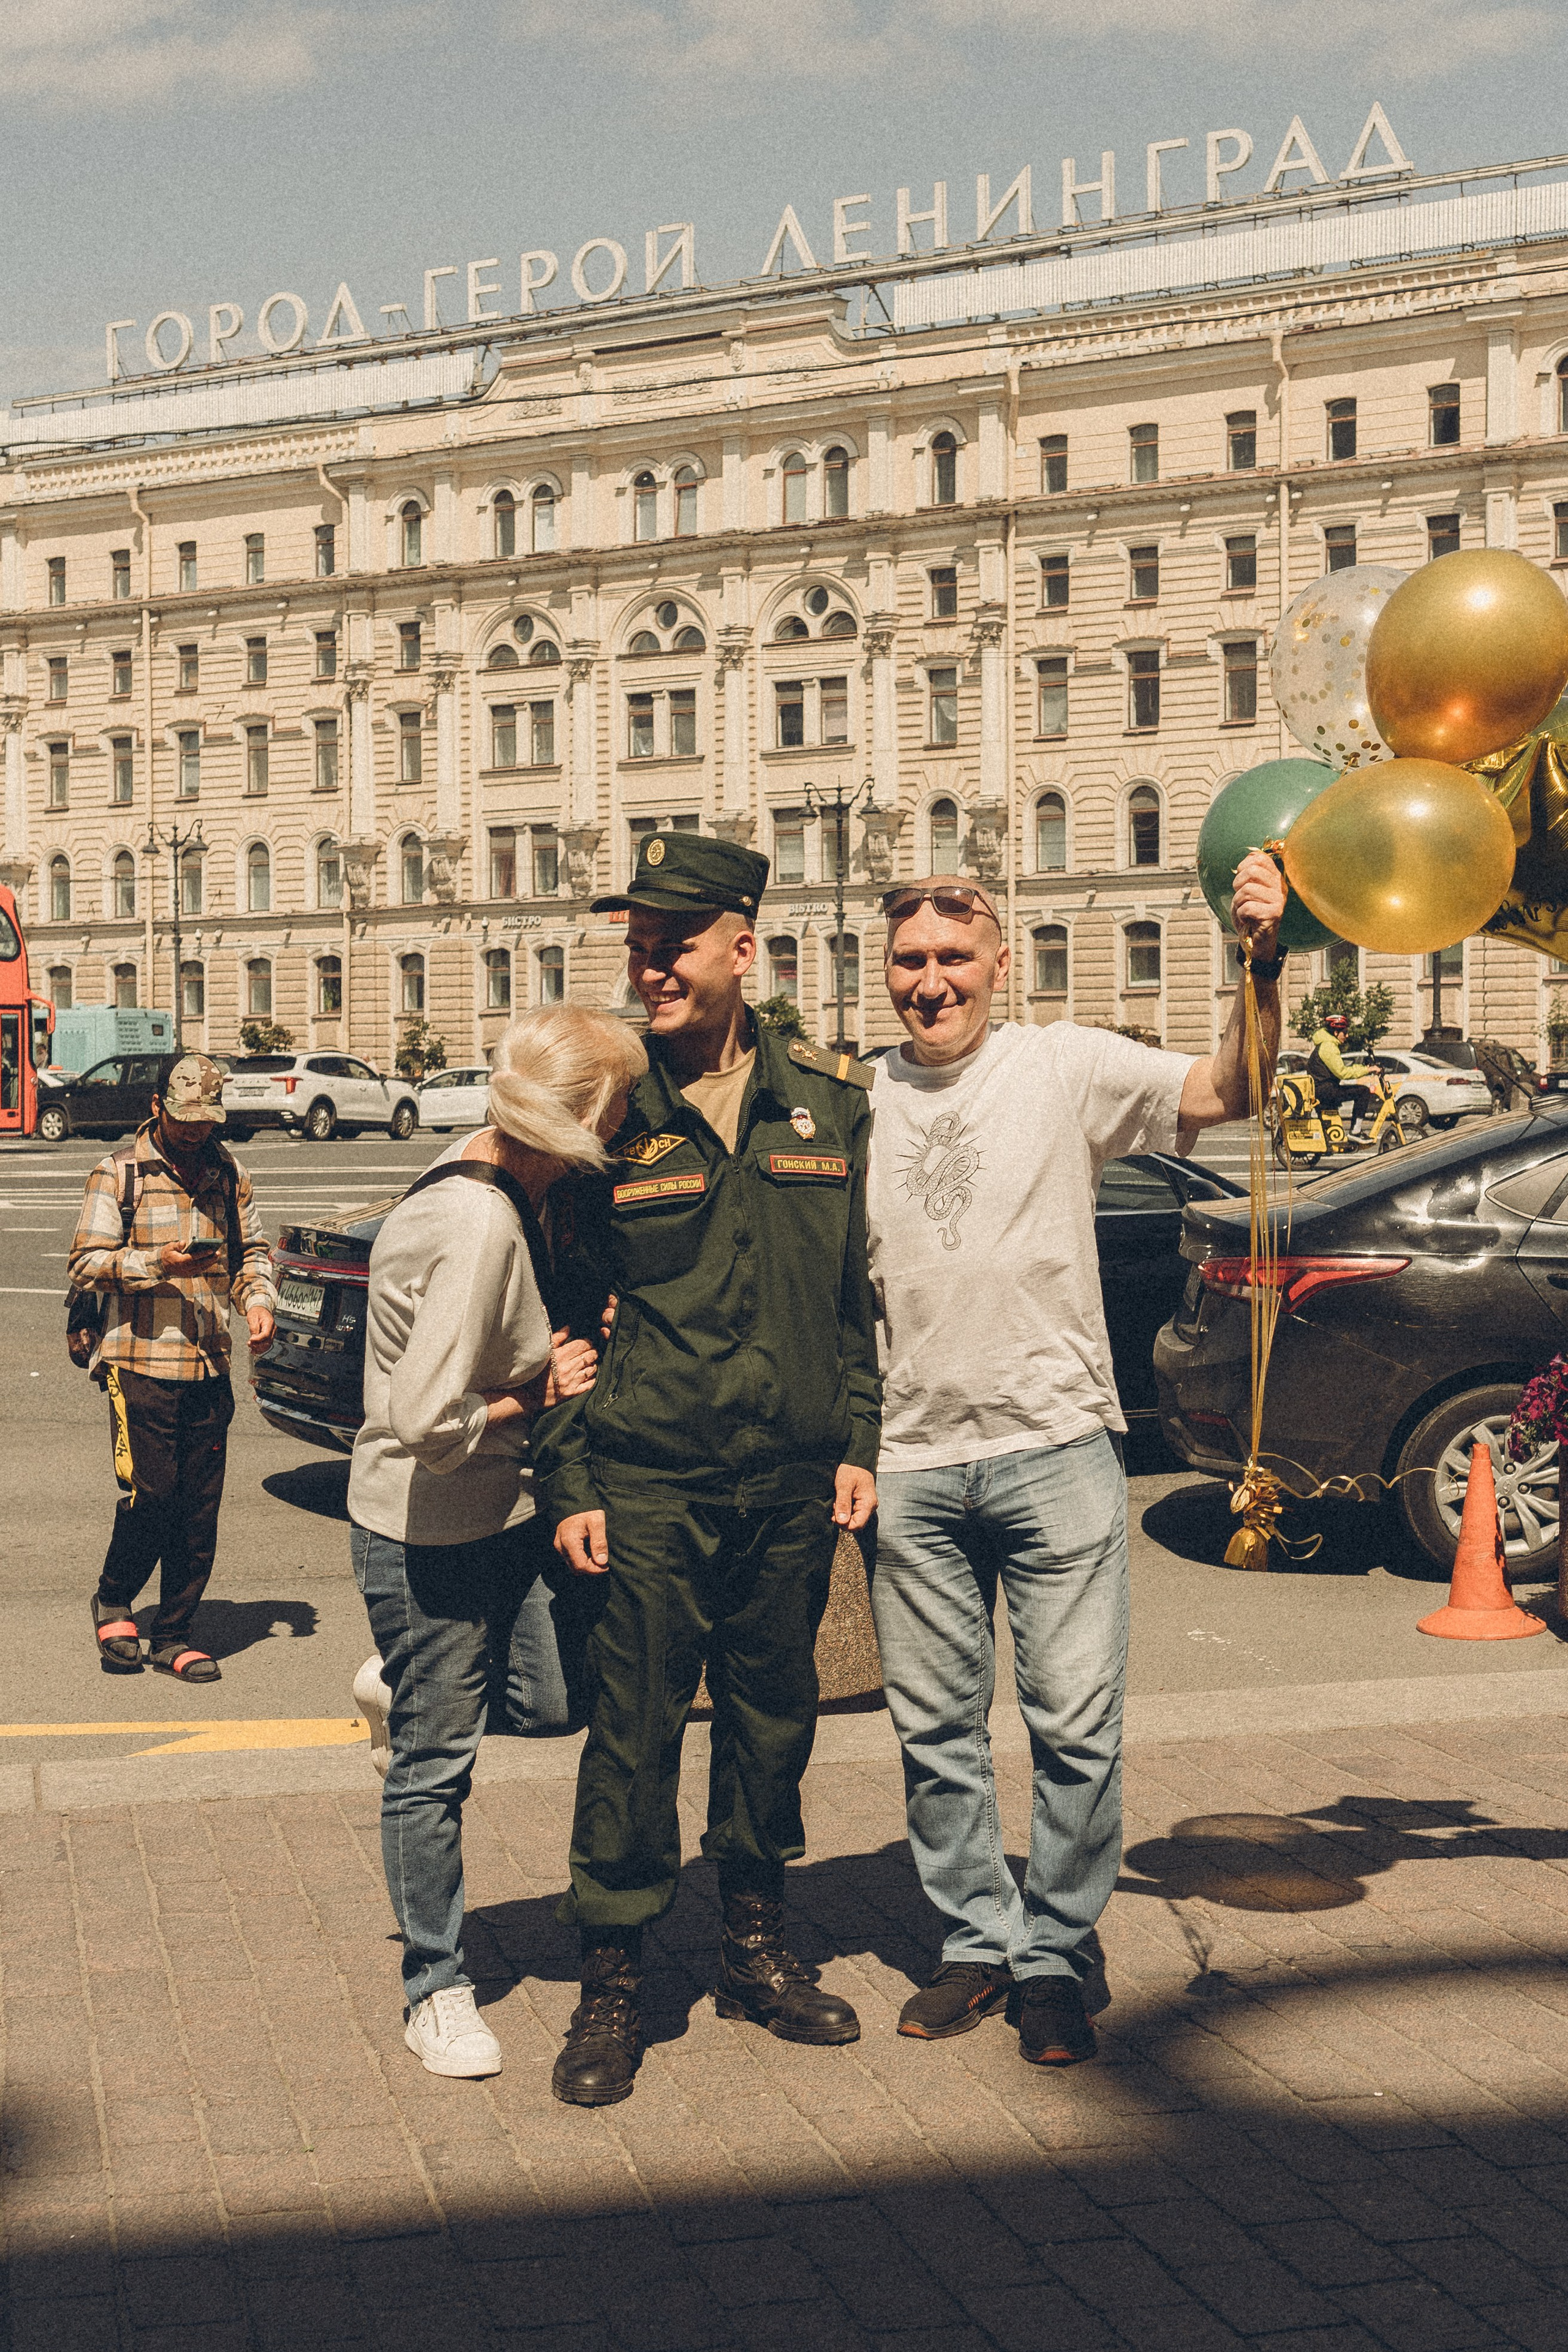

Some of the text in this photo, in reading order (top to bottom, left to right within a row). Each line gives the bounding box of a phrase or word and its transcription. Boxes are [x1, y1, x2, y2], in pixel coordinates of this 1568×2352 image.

[761, 101, 1414, 276] ЛЕНИНГРАД
[788, 902, 828, 914] BISTRO
[502, 916, 541, 927] БИСТРО
[777, 1159, 840, 1172] ГОНСКИЙ М.А.
[616, 1178, 702, 1199] ВООРУЖЕННЫЕ СИЛЫ РОССИИ
